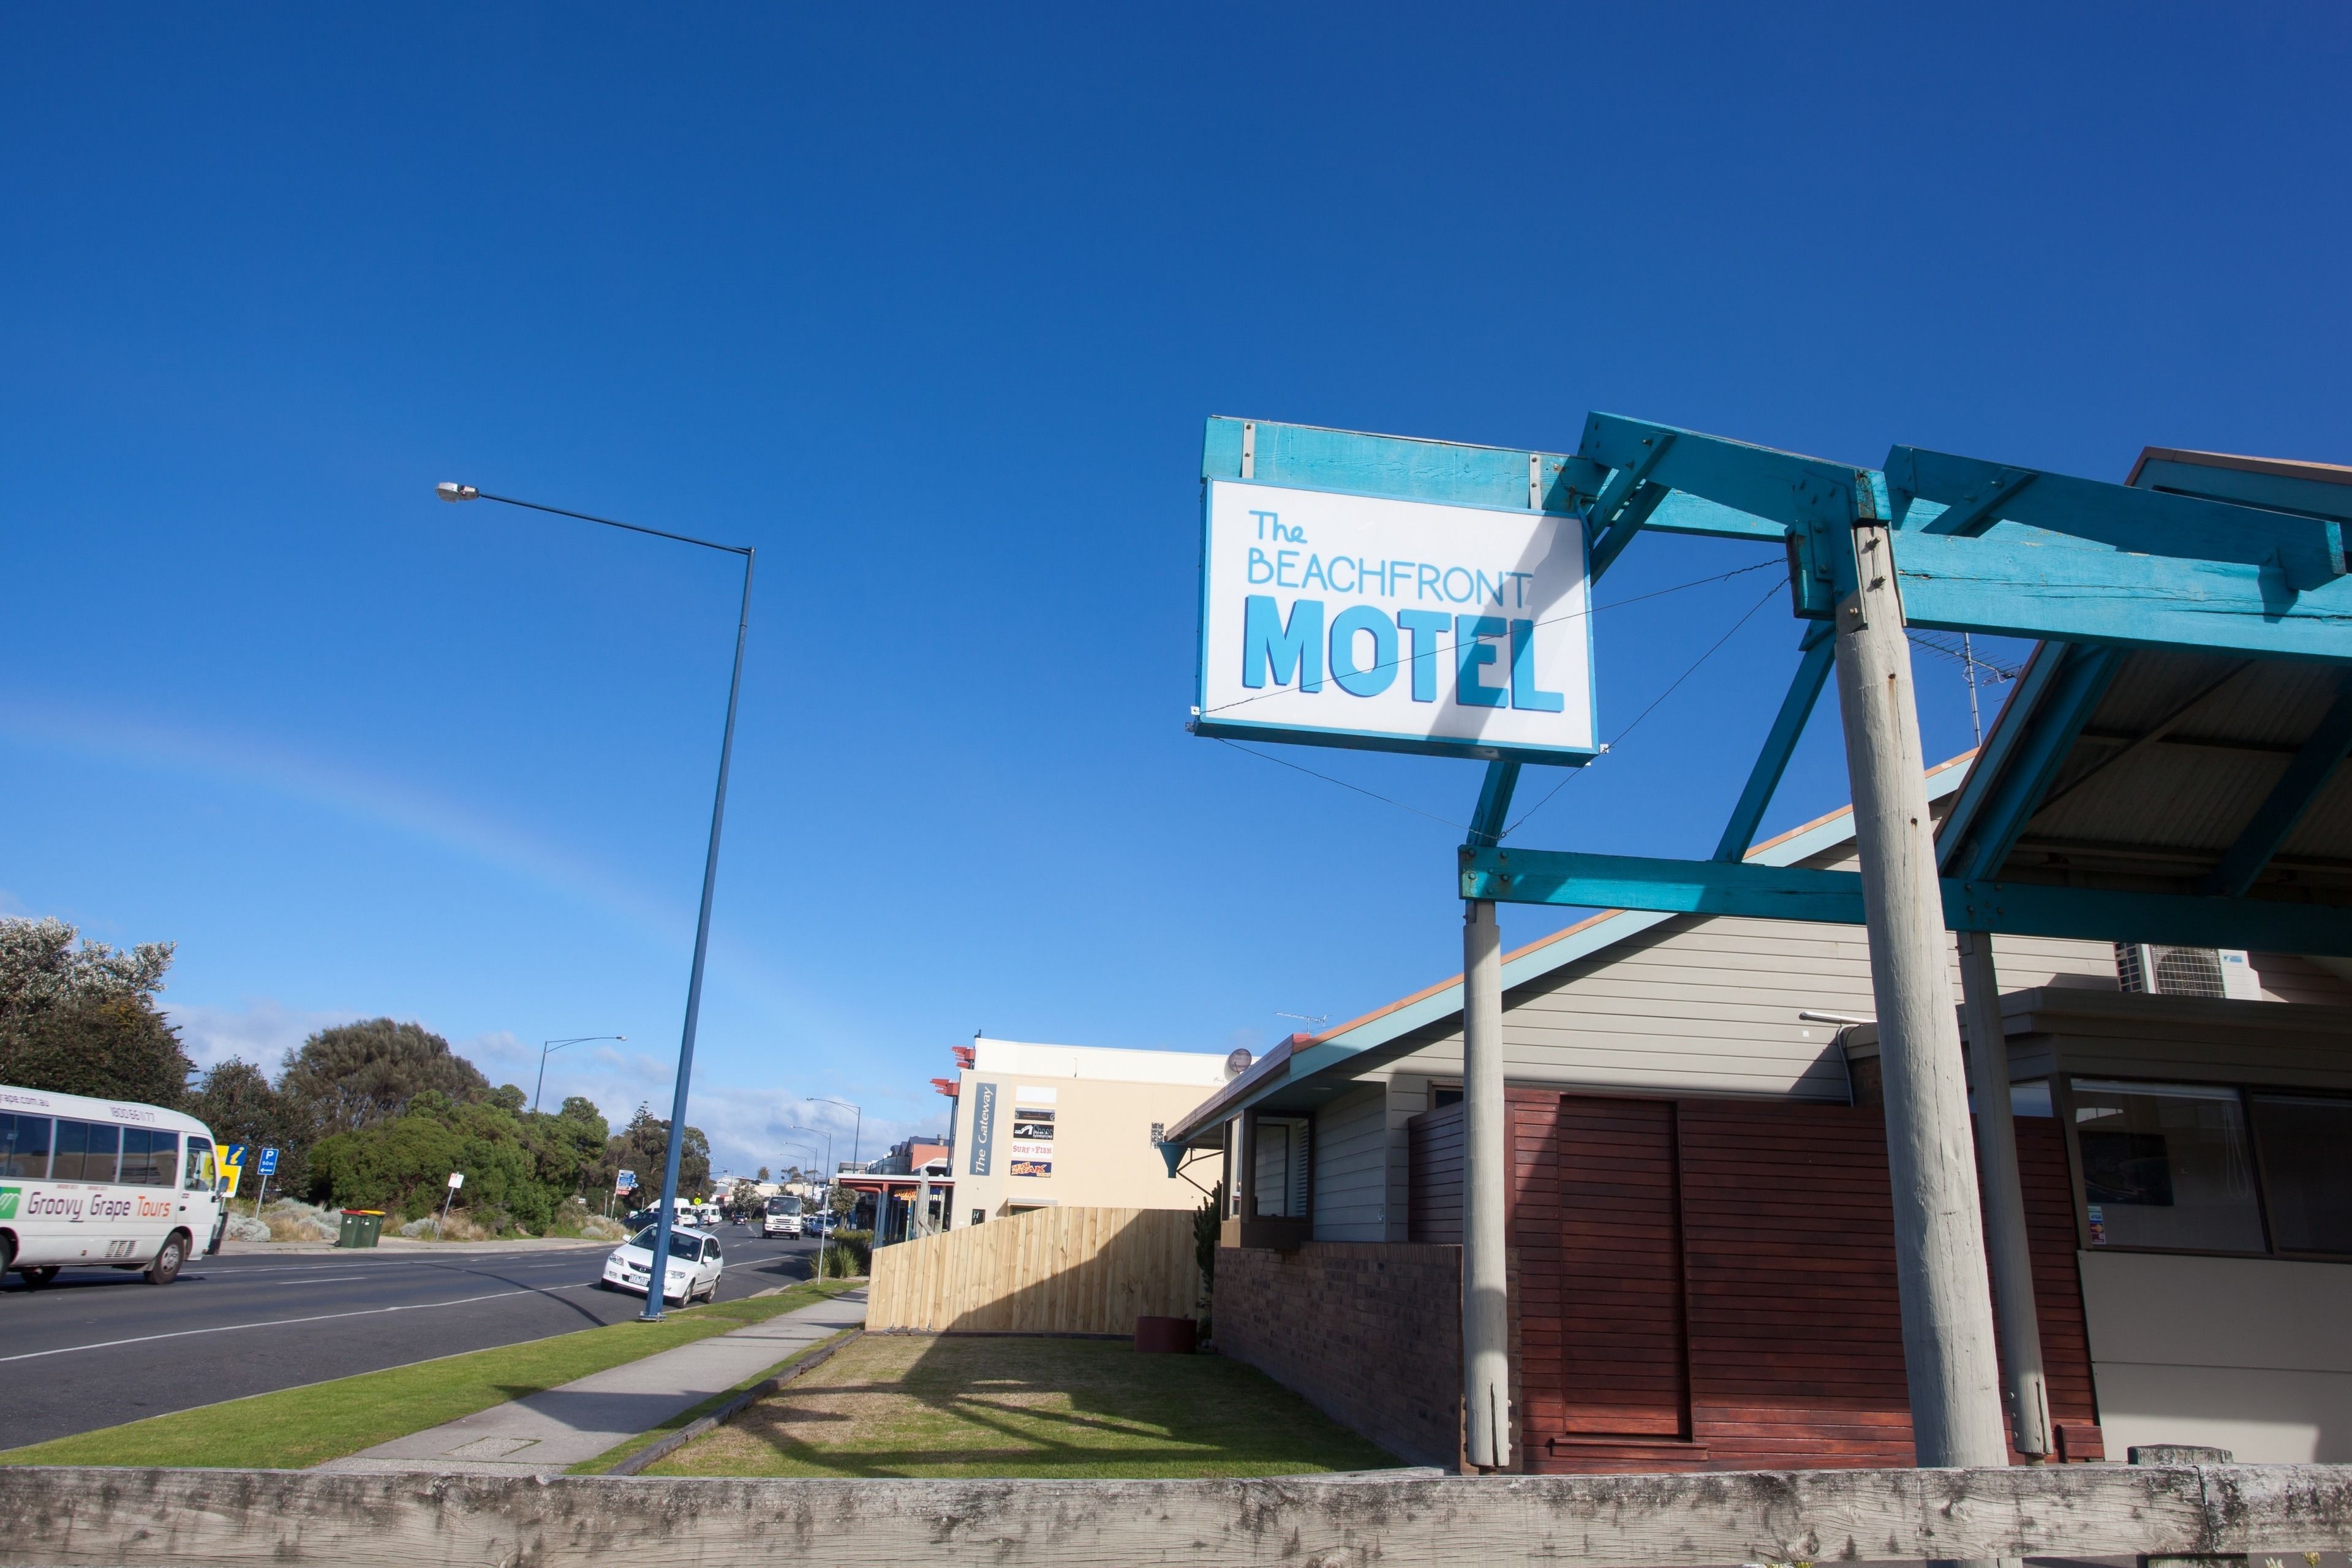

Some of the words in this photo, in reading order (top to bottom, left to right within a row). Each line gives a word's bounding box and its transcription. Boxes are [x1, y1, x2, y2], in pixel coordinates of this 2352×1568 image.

[1248, 510, 1308, 545] The
[1247, 547, 1534, 609] BEACHFRONT
[1242, 594, 1565, 712] MOTEL
[978, 1087, 993, 1144] Gateway
[266, 1151, 274, 1159] P
[976, 1149, 986, 1172] The
[1013, 1145, 1030, 1154] SURF
[1012, 1164, 1046, 1174] KAYAK
[28, 1191, 83, 1219] Groovy
[90, 1194, 131, 1221] Grape
[137, 1196, 172, 1217] Tours
